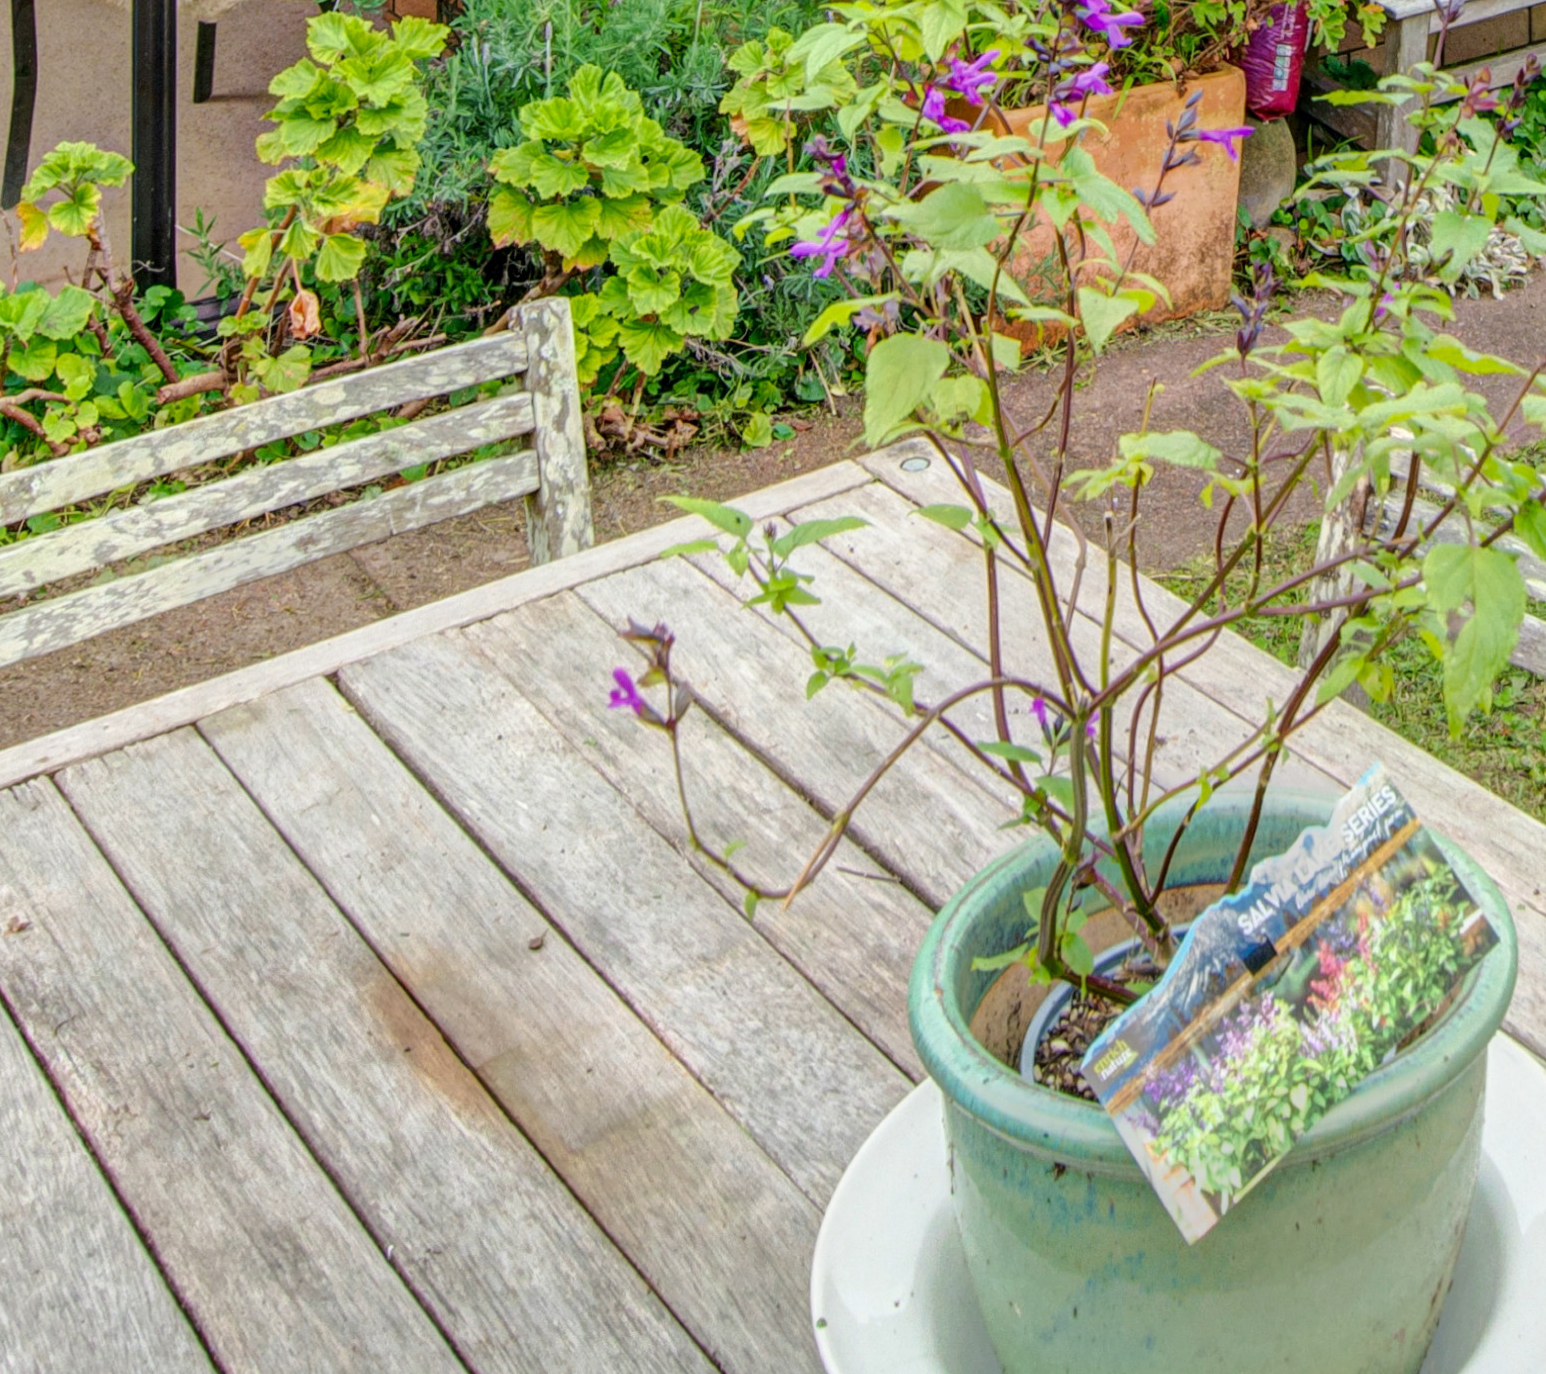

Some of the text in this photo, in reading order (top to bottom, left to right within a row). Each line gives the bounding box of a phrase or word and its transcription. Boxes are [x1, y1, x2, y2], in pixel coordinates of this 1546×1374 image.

[1237, 877, 1298, 936] SALVIA
[1292, 833, 1343, 884] LAKE
[1340, 785, 1397, 842] SERIES
[1094, 1039, 1128, 1073] enrich
